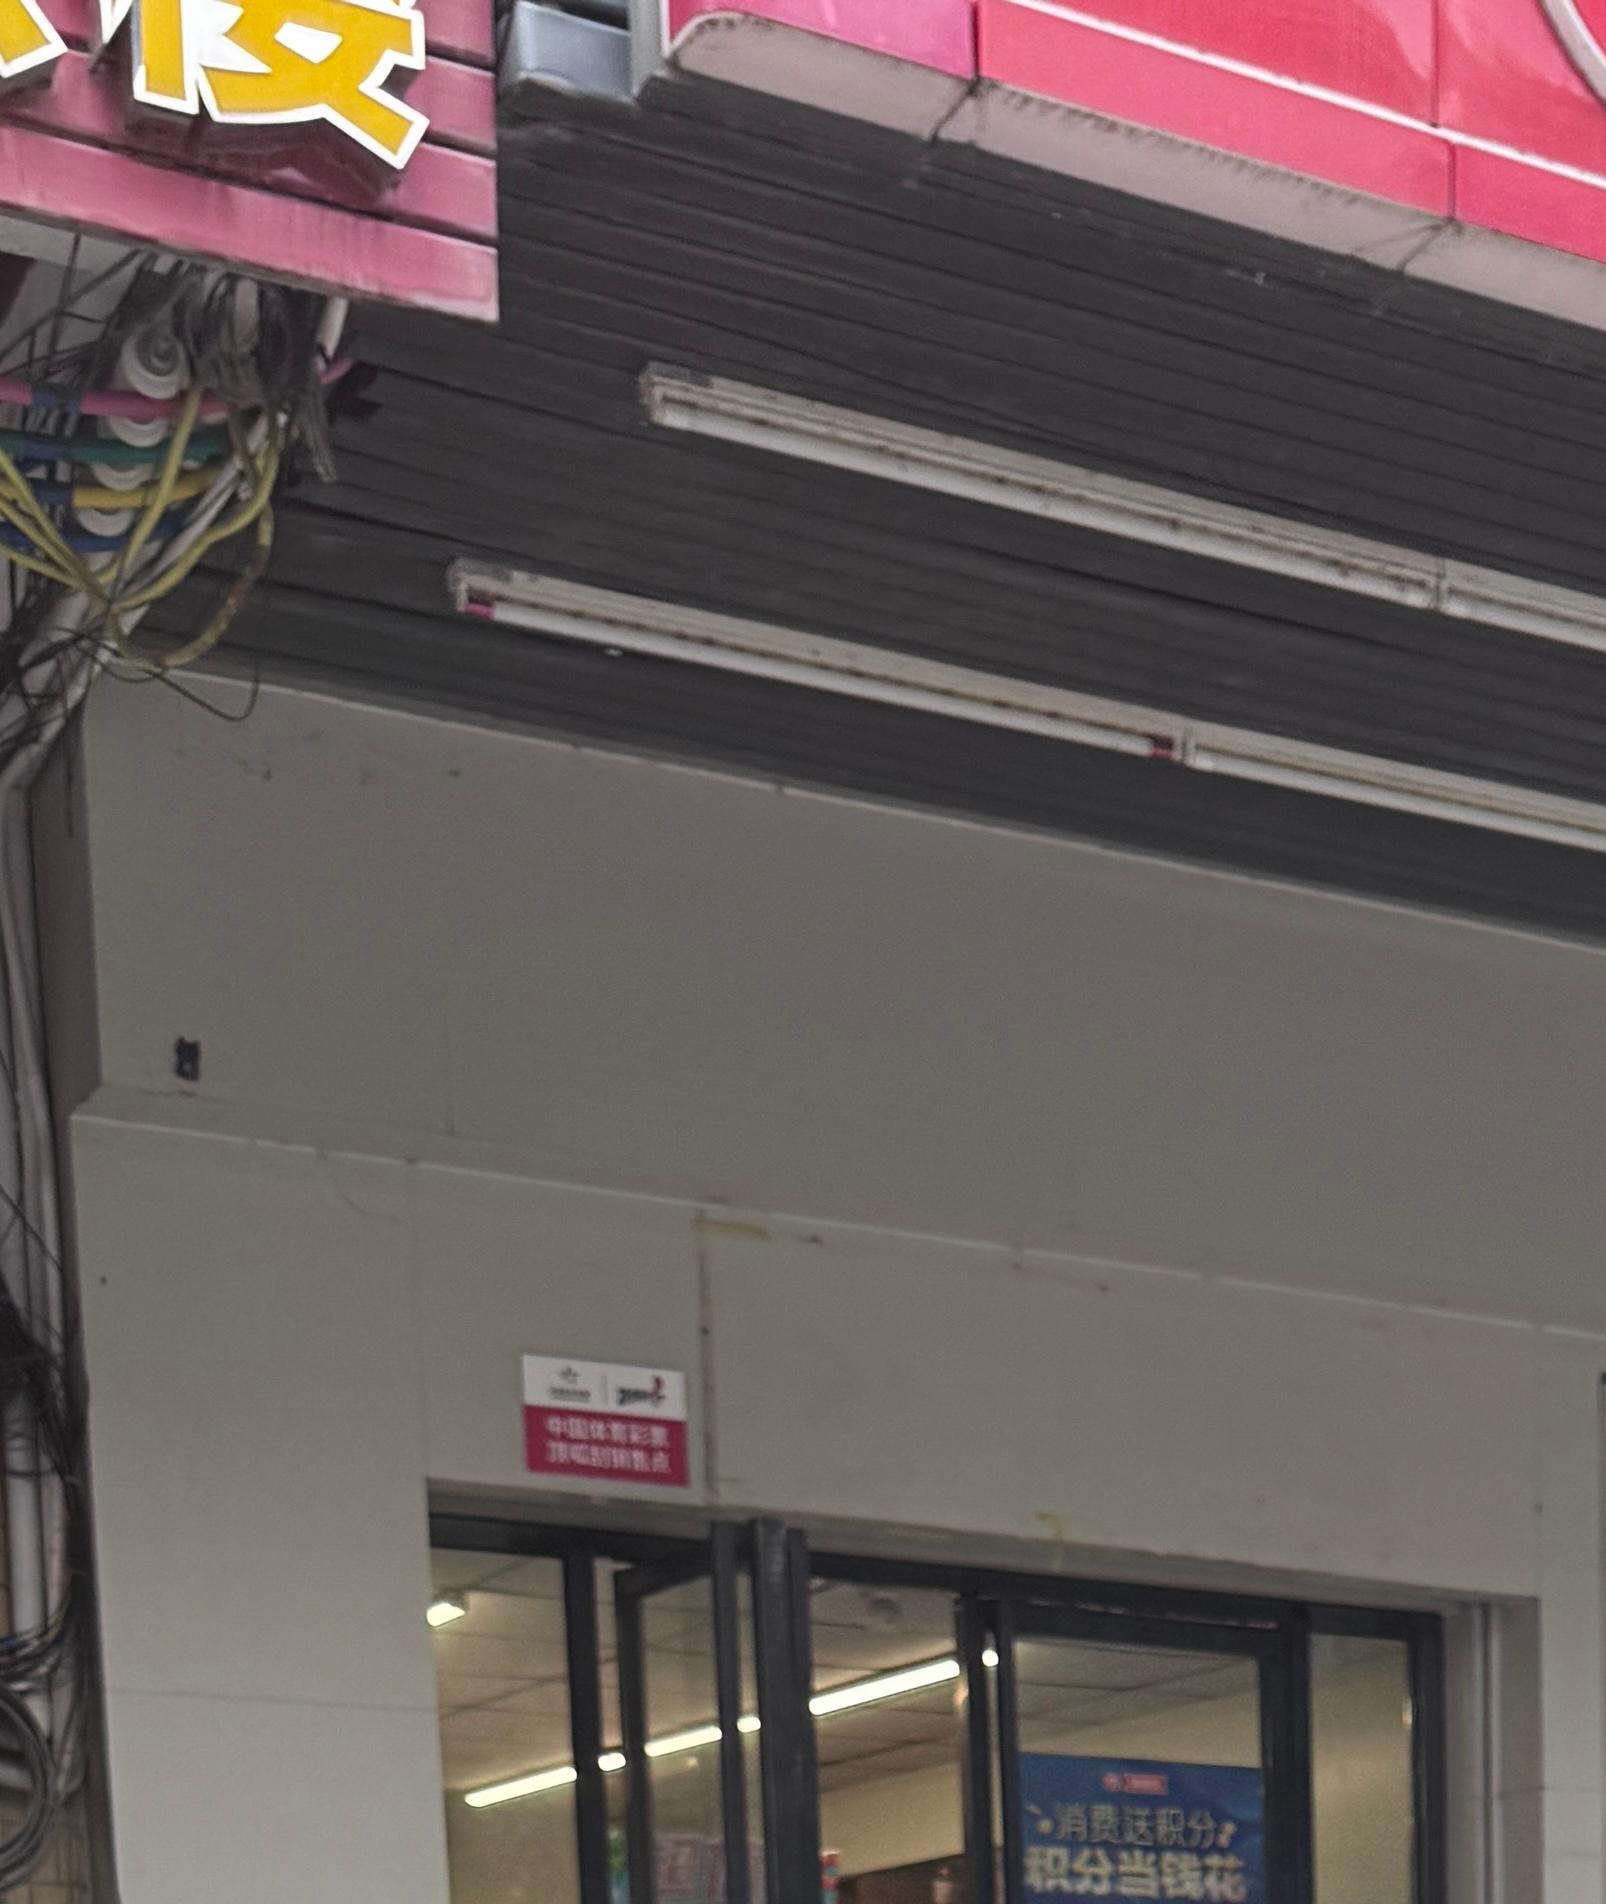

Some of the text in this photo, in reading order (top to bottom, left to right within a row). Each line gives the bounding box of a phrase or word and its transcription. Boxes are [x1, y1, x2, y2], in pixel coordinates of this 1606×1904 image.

[1055, 1804, 1216, 1848] 消费送积分
[1025, 1846, 1247, 1903] 积分当钱花
